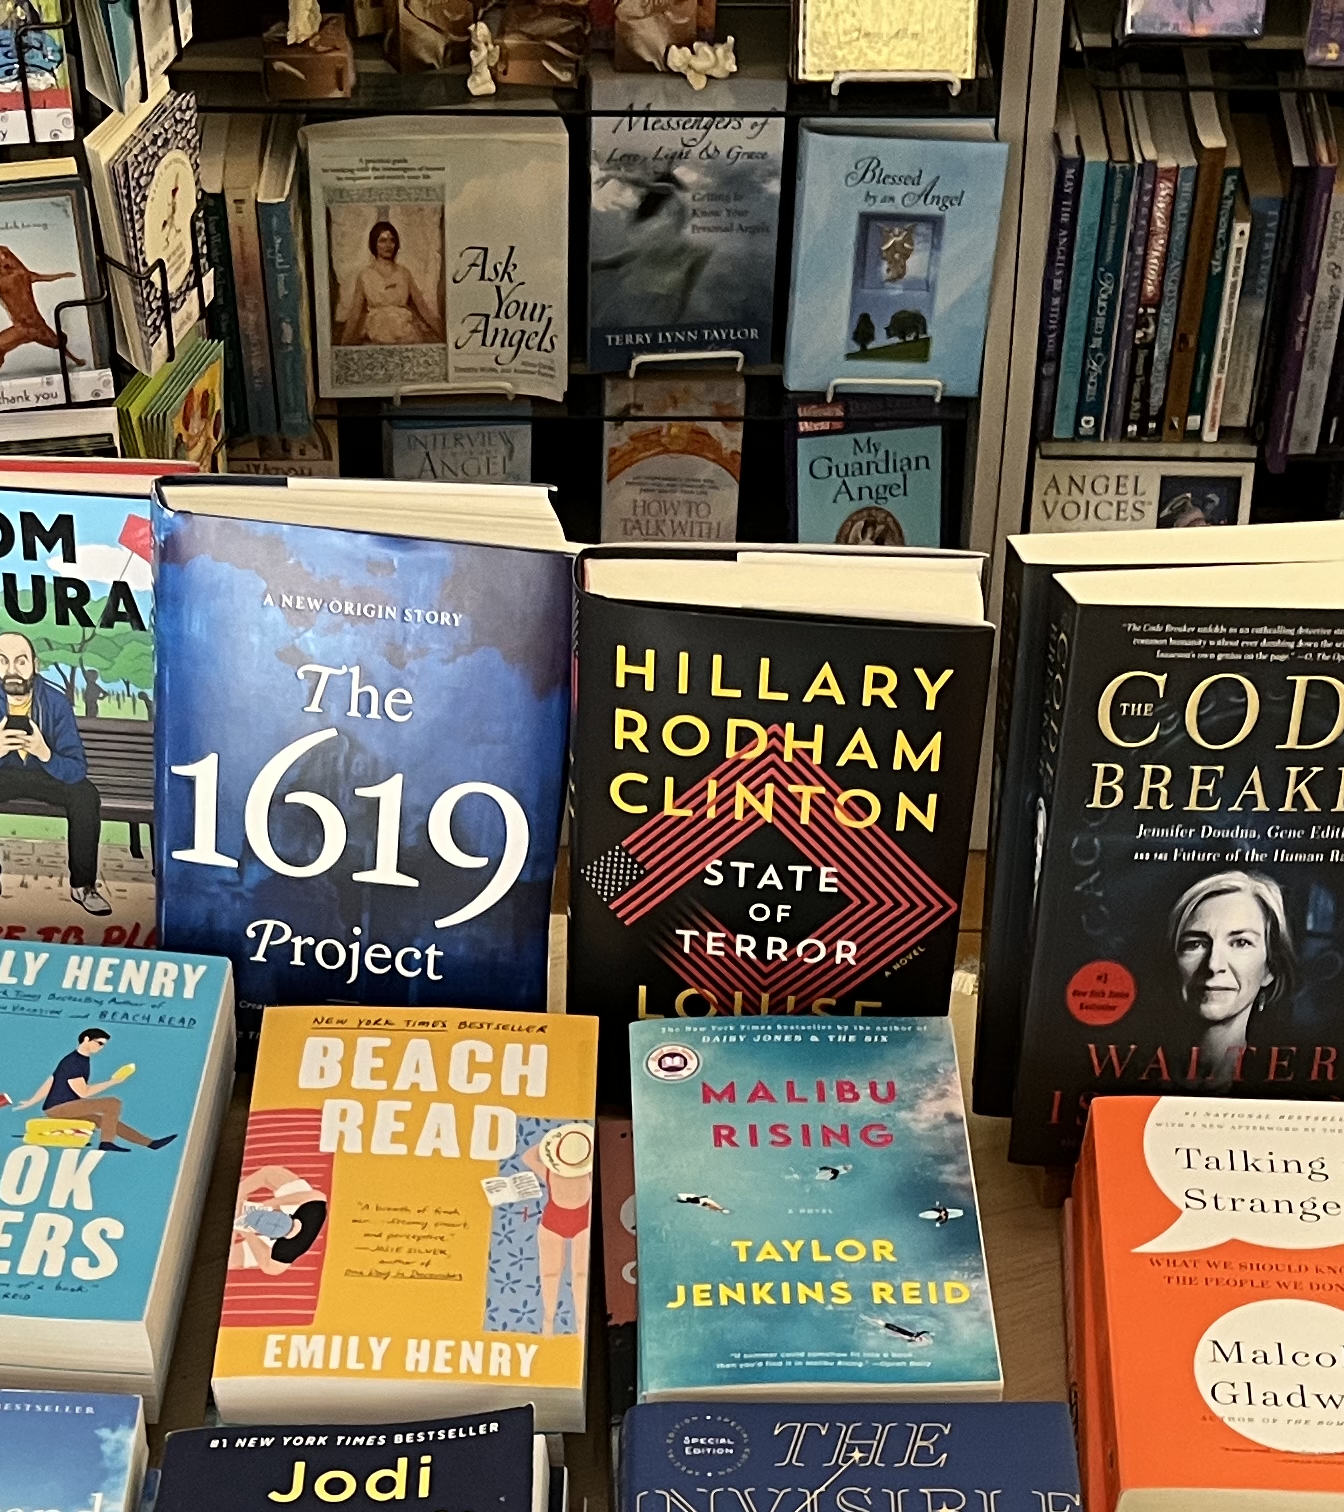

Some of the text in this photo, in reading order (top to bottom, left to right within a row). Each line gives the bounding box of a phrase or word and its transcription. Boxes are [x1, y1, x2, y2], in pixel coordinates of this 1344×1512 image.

[844, 156, 922, 188] Blessed
[901, 175, 964, 211] Angel
[452, 245, 518, 284] Ask
[494, 282, 553, 323] Your
[455, 313, 558, 366] Angels
[605, 328, 760, 347] TERRY LYNN TAYLOR
[30, 389, 59, 405] you
[852, 437, 882, 457] My
[808, 454, 932, 480] Guardian
[833, 479, 908, 504] Angel
[1042, 473, 1147, 497] ANGEL
[1042, 499, 1147, 522] VOICES
[263, 594, 463, 628] A NEW ORIGIN STORY
[297, 665, 414, 722] The
[615, 645, 954, 711] HILLARY
[1120, 703, 1154, 716] THE
[614, 708, 942, 772] RODHAM
[610, 773, 938, 832] CLINTON
[171, 728, 530, 929] 1619
[1135, 824, 1261, 840] Jennifer Doudna,
[703, 860, 839, 893] STATE
[749, 903, 791, 922] OF
[246, 919, 444, 982] Project
[675, 929, 857, 965] TERROR
[62, 955, 207, 998] HENRY
[298, 1036, 548, 1097] BEACH
[1087, 1044, 1338, 1081] WALTER
[701, 1080, 896, 1105] MALIBU
[319, 1099, 517, 1161] READ
[712, 1124, 895, 1148] RISING
[1175, 1147, 1328, 1182] Talking
[731, 1240, 897, 1262] TAYLOR
[666, 1281, 970, 1309] JENKINS REID
[263, 1334, 539, 1378] EMILY HENRY
[773, 1421, 952, 1468] THE
[267, 1455, 433, 1503] Jodi
